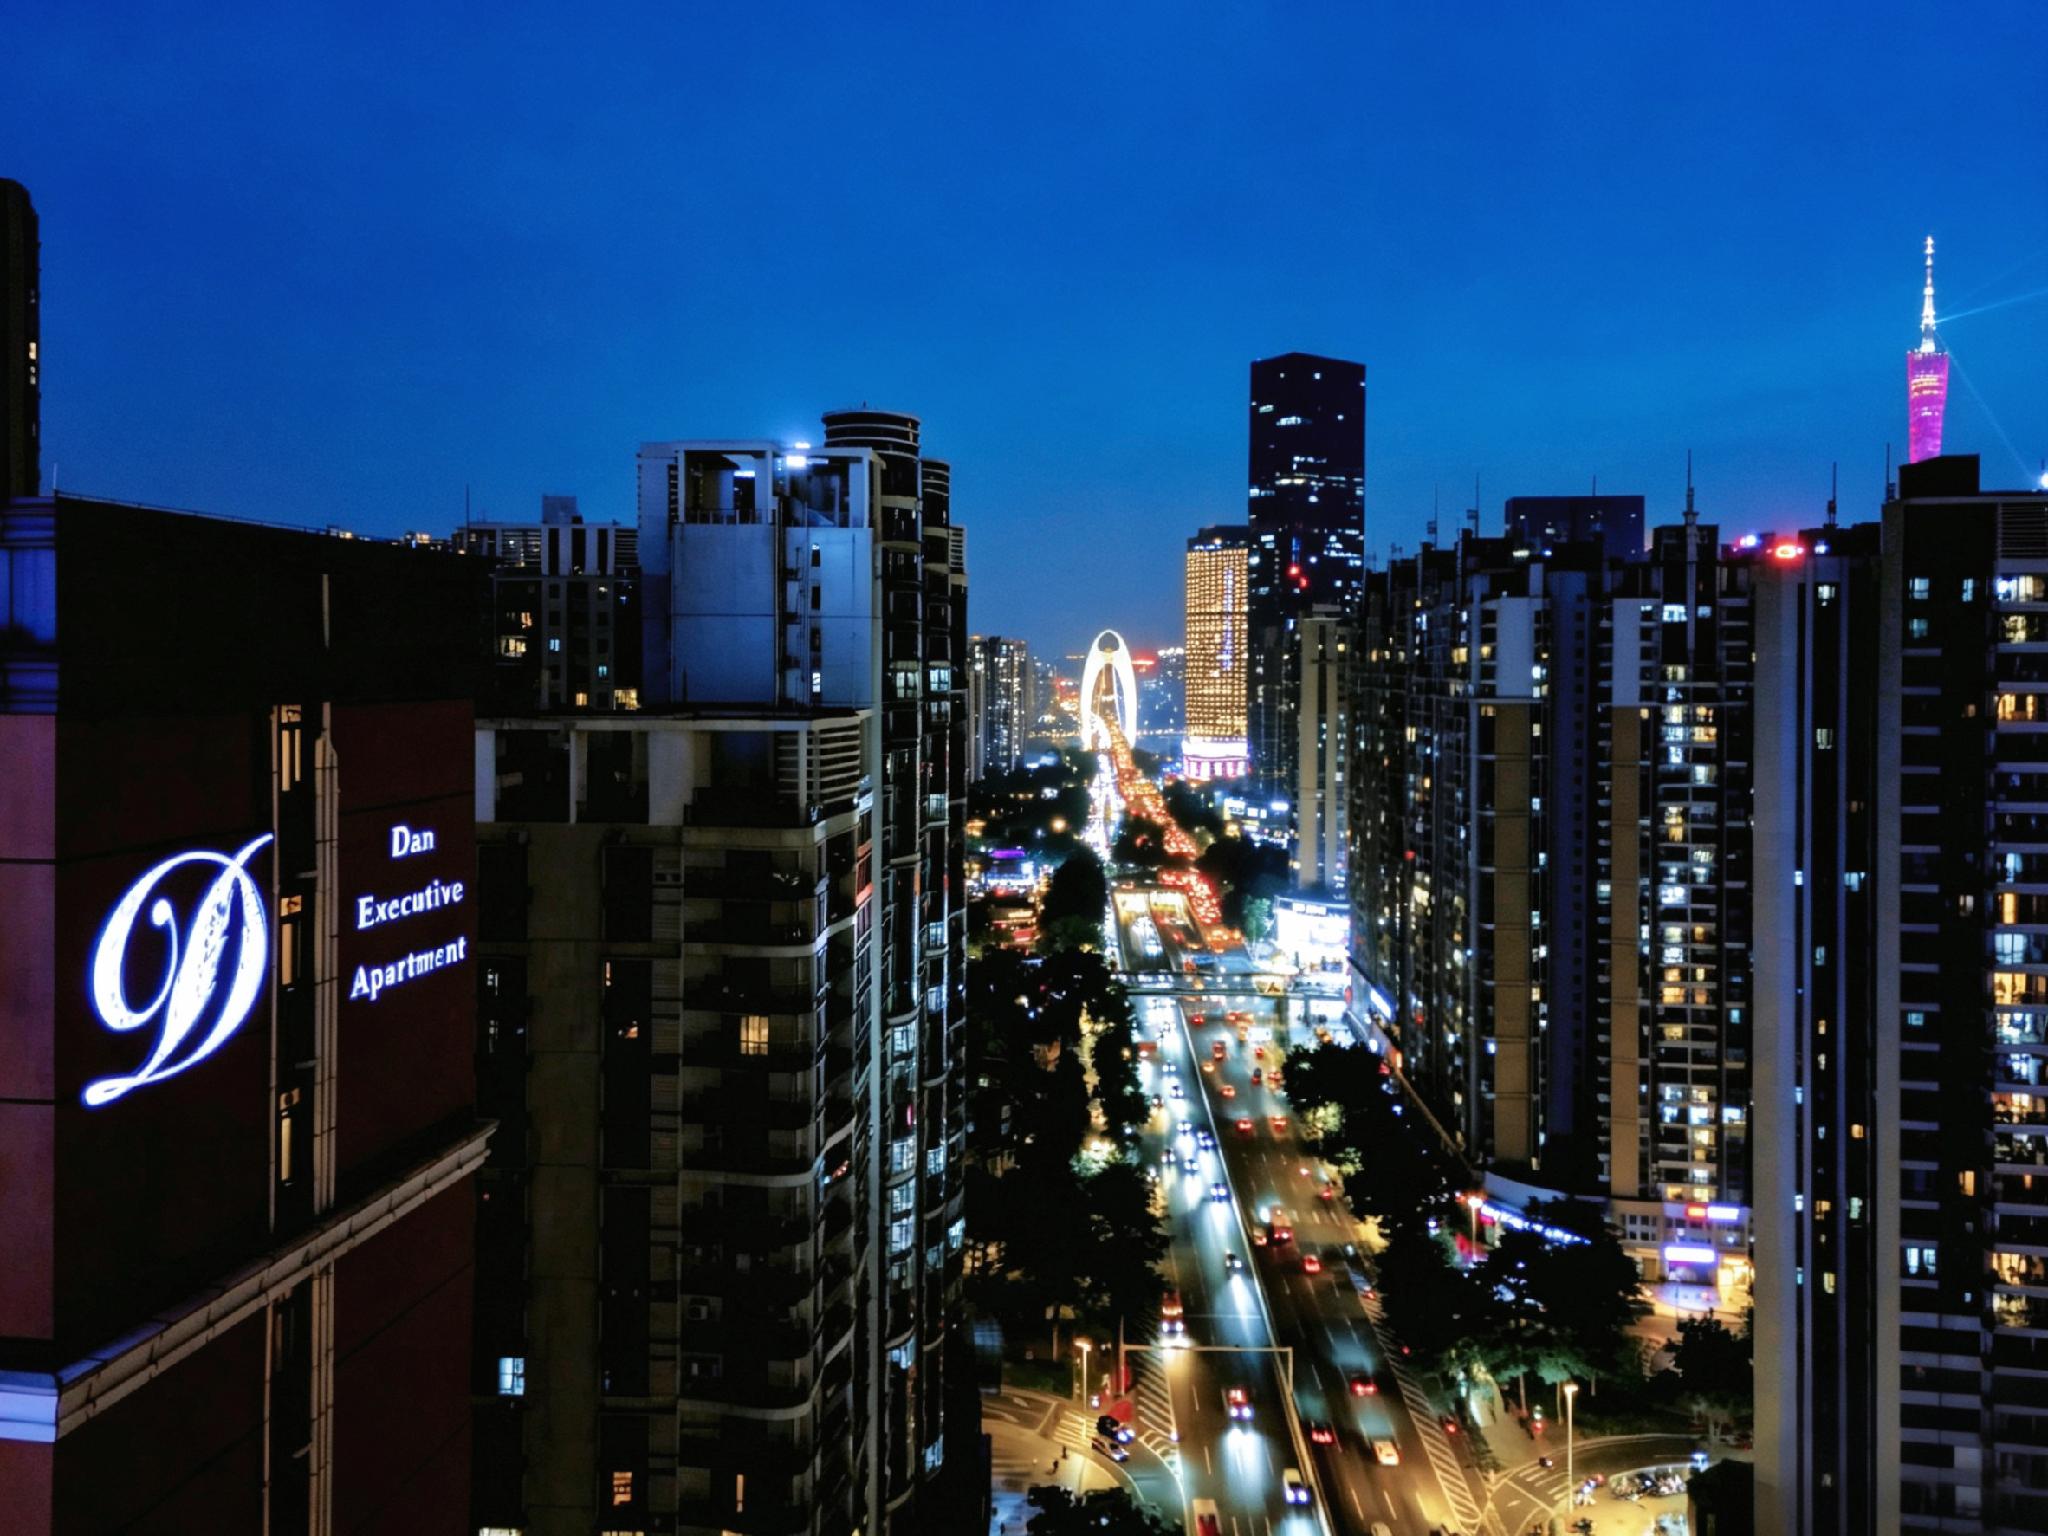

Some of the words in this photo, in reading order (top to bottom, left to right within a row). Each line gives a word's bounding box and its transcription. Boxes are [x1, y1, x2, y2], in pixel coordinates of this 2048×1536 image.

[391, 825, 434, 858] Dan
[357, 879, 464, 930] Executive
[349, 936, 467, 1001] Apartment
